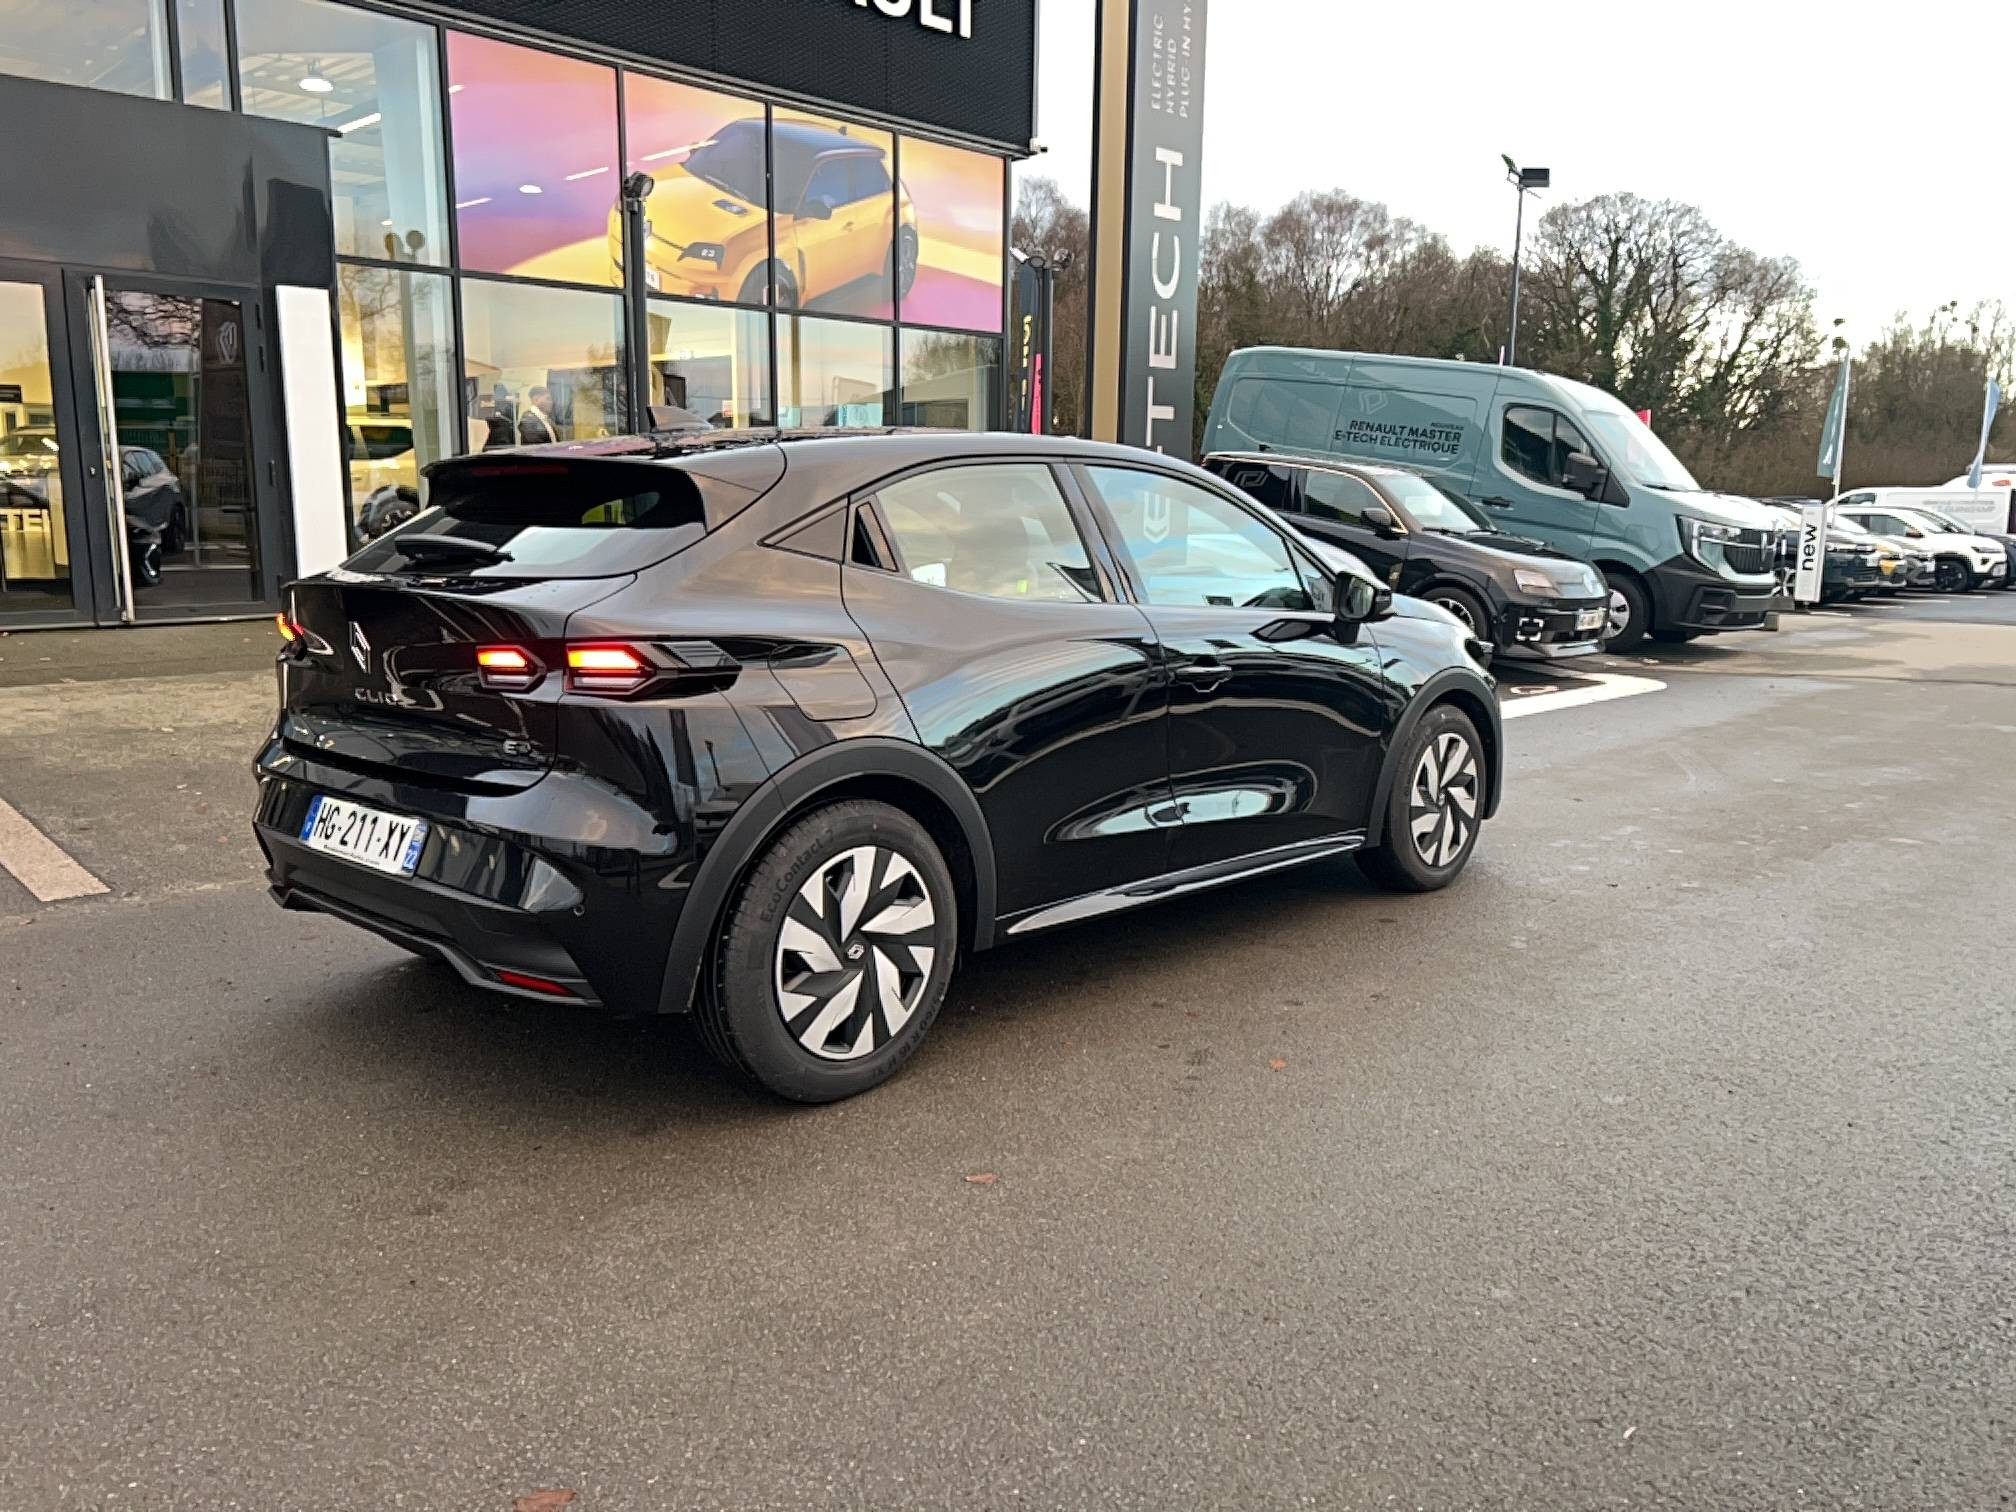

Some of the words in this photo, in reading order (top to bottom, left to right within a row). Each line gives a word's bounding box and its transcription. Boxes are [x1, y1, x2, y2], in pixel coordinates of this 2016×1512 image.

[1183, 0, 1193, 31] HY
[1151, 13, 1164, 110] ELECTRIC
[1166, 38, 1177, 114] HYBRID
[1179, 35, 1191, 118] PLUG-IN
[1334, 429, 1378, 445] E-TECH
[1379, 435, 1460, 455] ELECTRIQUE
[1350, 420, 1407, 437] RENAULT
[1407, 426, 1462, 443] MASTER
[1801, 522, 1818, 572] new
[354, 688, 398, 706] CLIO
[313, 802, 412, 862] HG-211-XY
[759, 837, 824, 923] EcoContact
